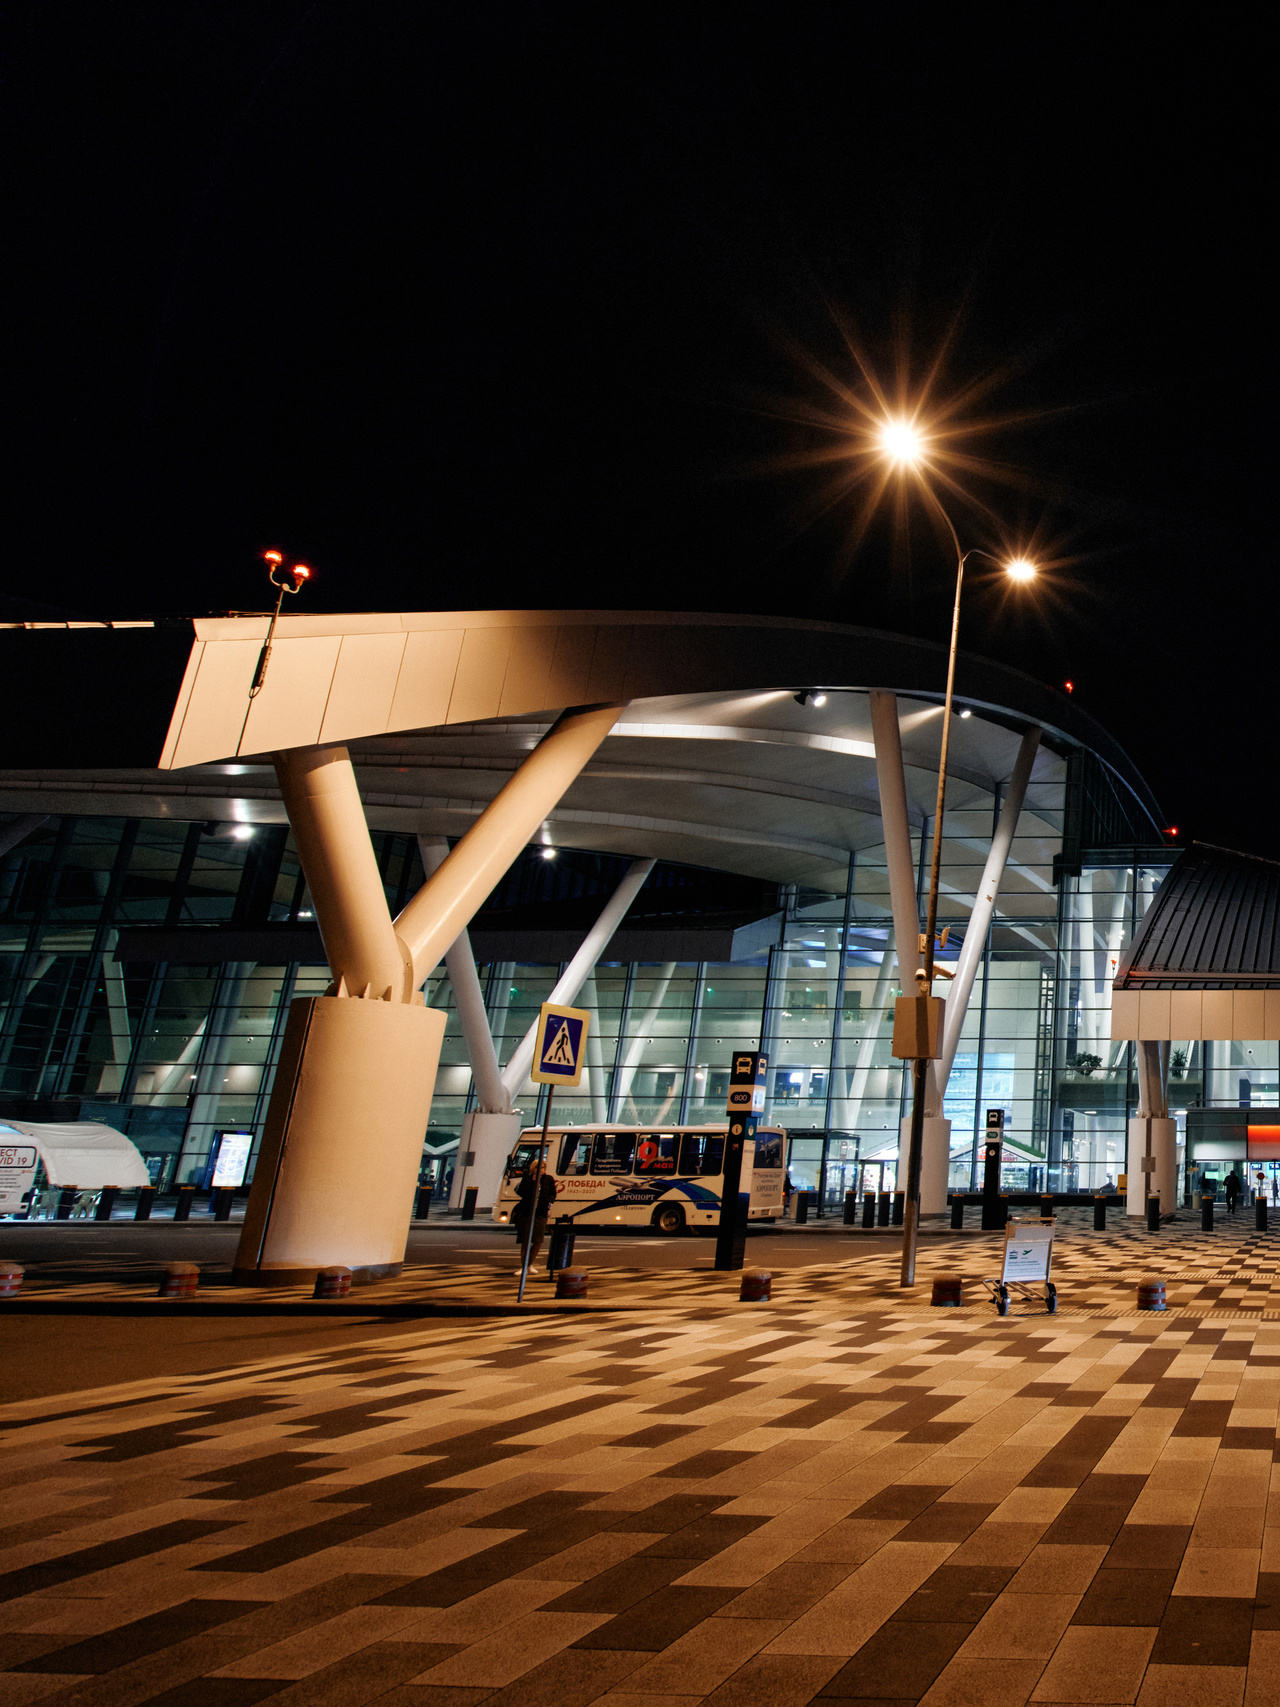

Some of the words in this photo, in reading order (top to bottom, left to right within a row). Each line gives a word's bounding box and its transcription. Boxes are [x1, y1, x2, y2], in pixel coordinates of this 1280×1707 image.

[734, 1094, 748, 1102] 800
[639, 1141, 657, 1169] 9
[17, 1157, 28, 1165] 19
[567, 1180, 605, 1188] ПОБЕДА!
